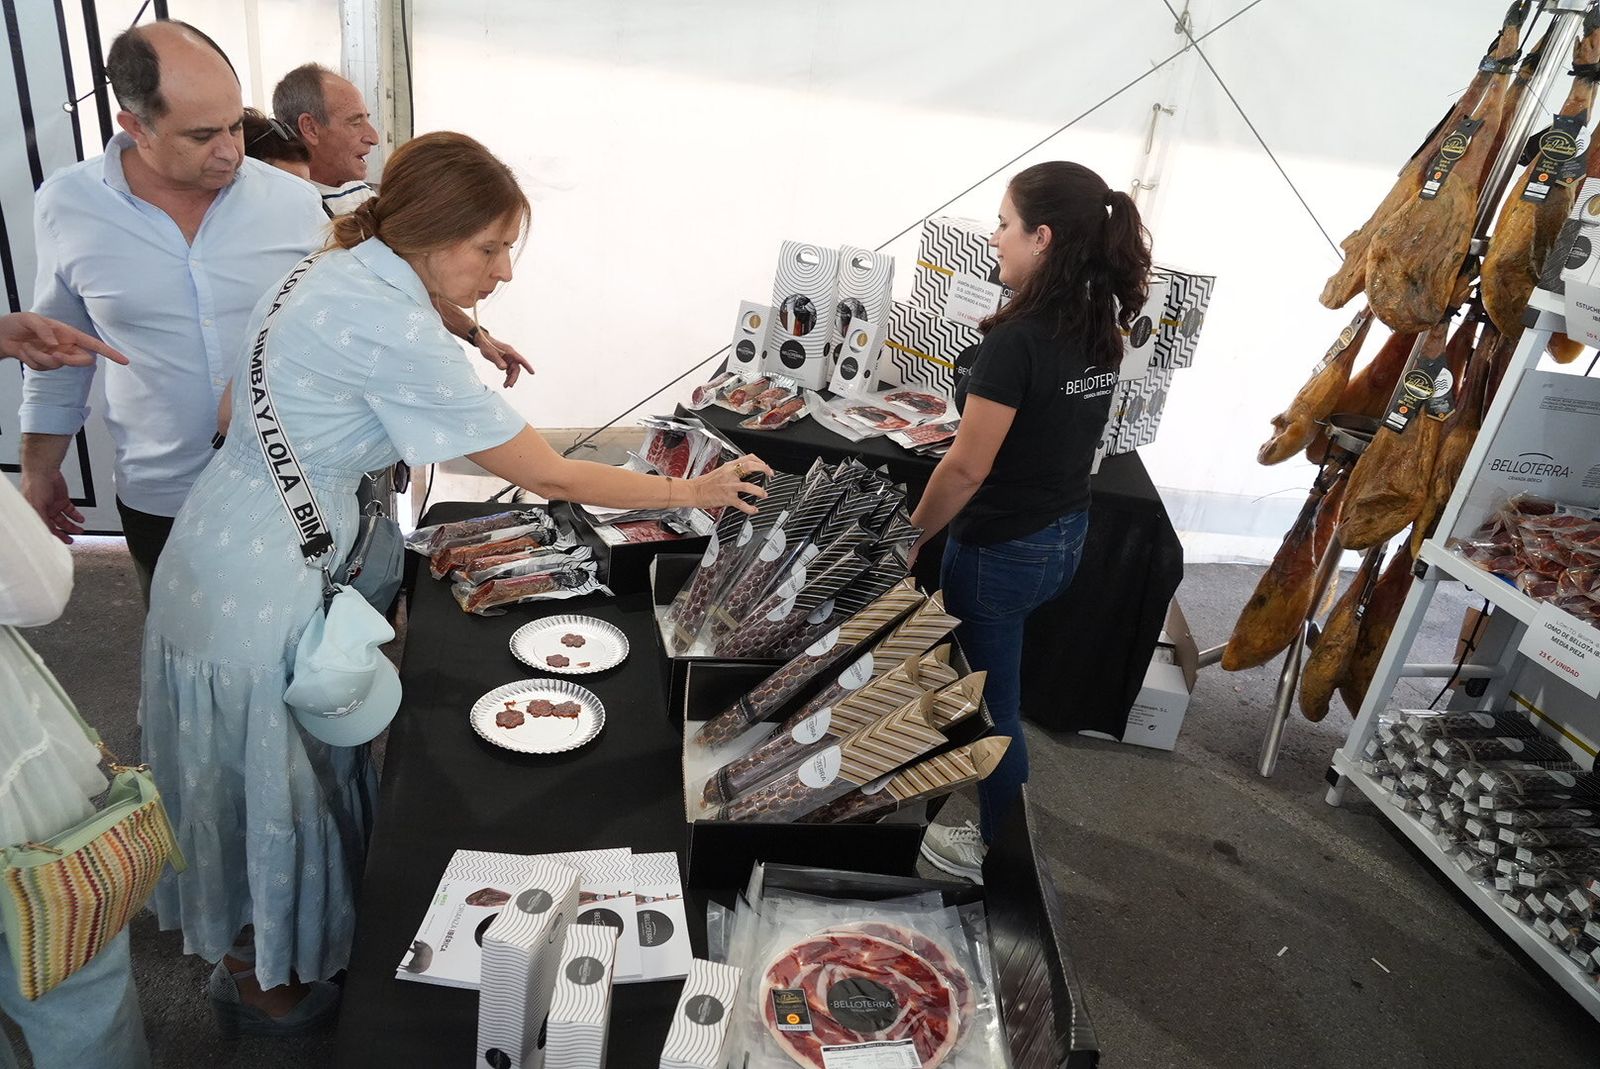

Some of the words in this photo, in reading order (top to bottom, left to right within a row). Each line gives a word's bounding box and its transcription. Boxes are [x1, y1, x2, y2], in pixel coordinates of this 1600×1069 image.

[268, 268, 307, 318] LOLA
[251, 327, 269, 405] BIMBA
[256, 405, 275, 423] Y
[261, 428, 302, 494] LOLA
[1491, 458, 1570, 478] BELLOTERRA
[1544, 621, 1562, 635] LOMO
[1561, 631, 1570, 640] DE
[1568, 636, 1594, 653] BELLOTA
[1550, 635, 1569, 650] MEDIA
[1568, 646, 1585, 660] PIEZA
[1555, 660, 1580, 678] UNIDAD
[833, 1000, 894, 1009] BELLOTERRA
